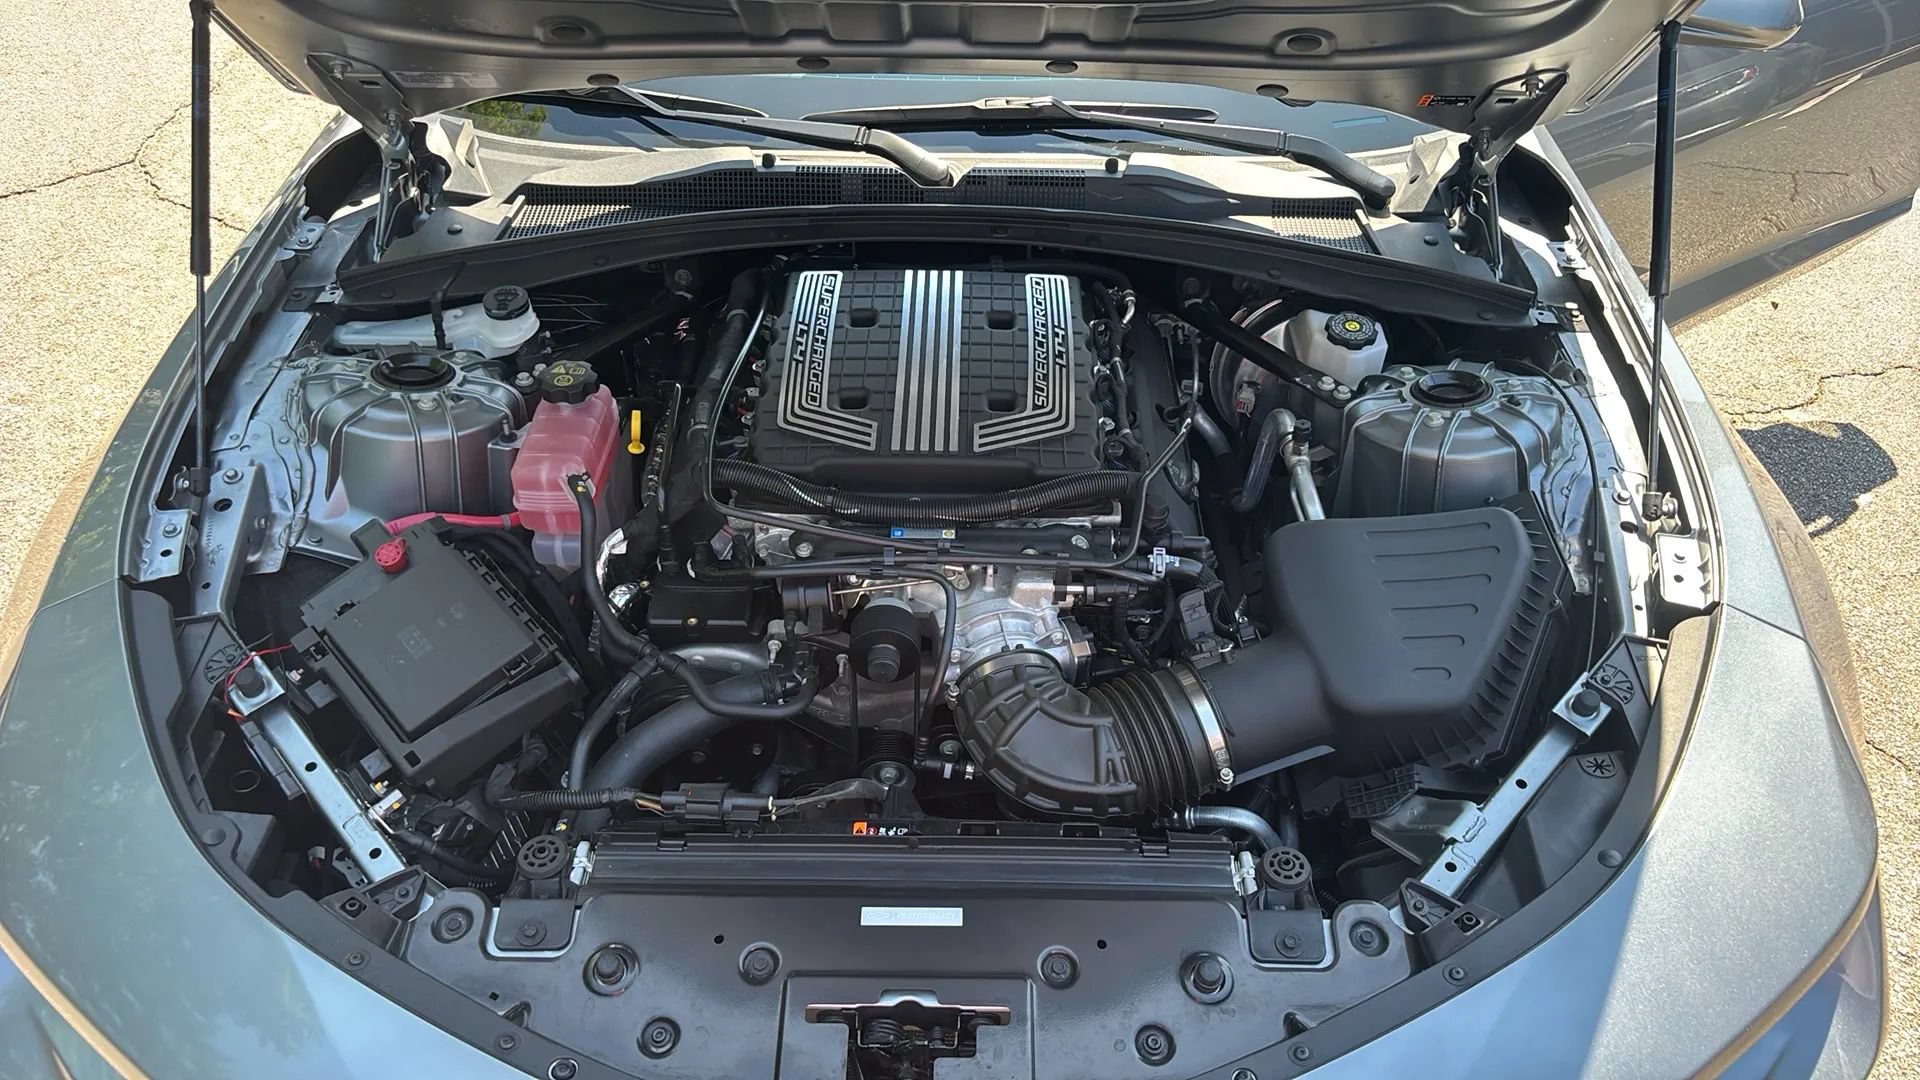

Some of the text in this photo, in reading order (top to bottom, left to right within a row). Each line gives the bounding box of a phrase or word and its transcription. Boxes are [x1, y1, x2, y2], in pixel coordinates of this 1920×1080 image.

[793, 322, 808, 361] LT4
[806, 274, 836, 406] SUPERCHARGED
[1032, 277, 1048, 407] SUPERCHARGED
[1055, 327, 1066, 367] LT4
